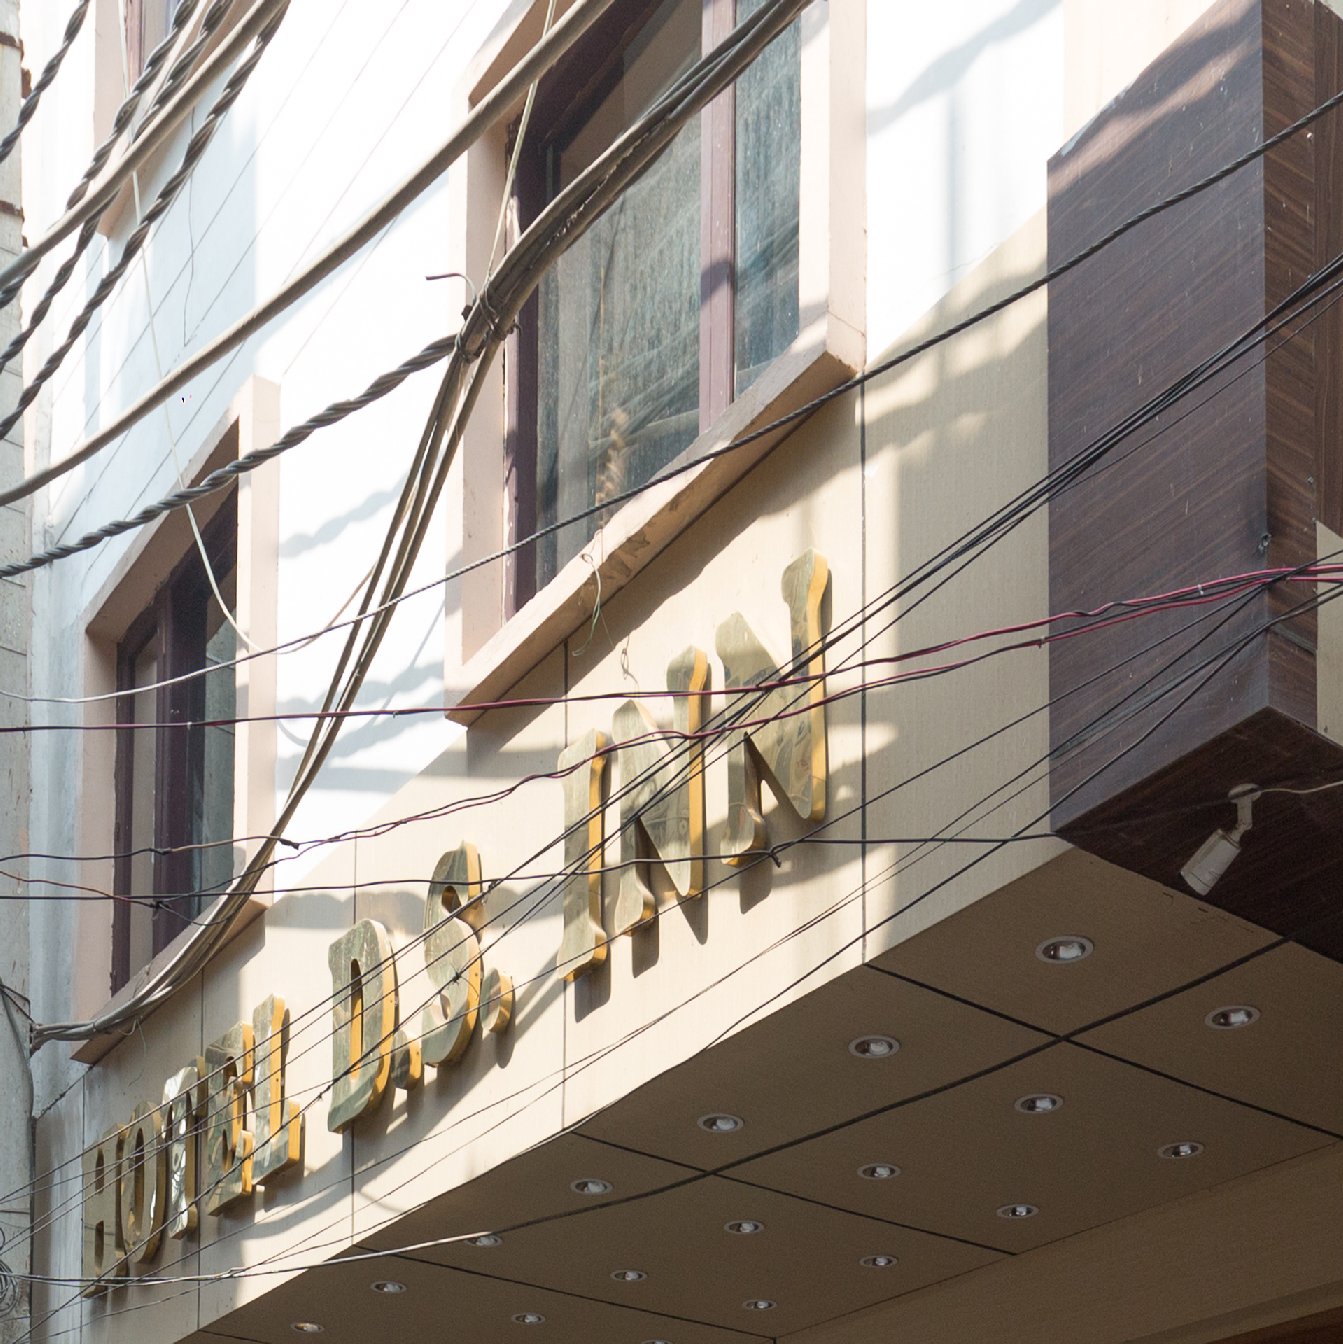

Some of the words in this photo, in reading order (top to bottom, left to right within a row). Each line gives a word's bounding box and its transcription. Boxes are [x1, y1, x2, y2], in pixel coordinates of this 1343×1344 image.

[81, 992, 302, 1298] HOTEL
[327, 841, 515, 1134] D.S.
[559, 548, 830, 982] INN
